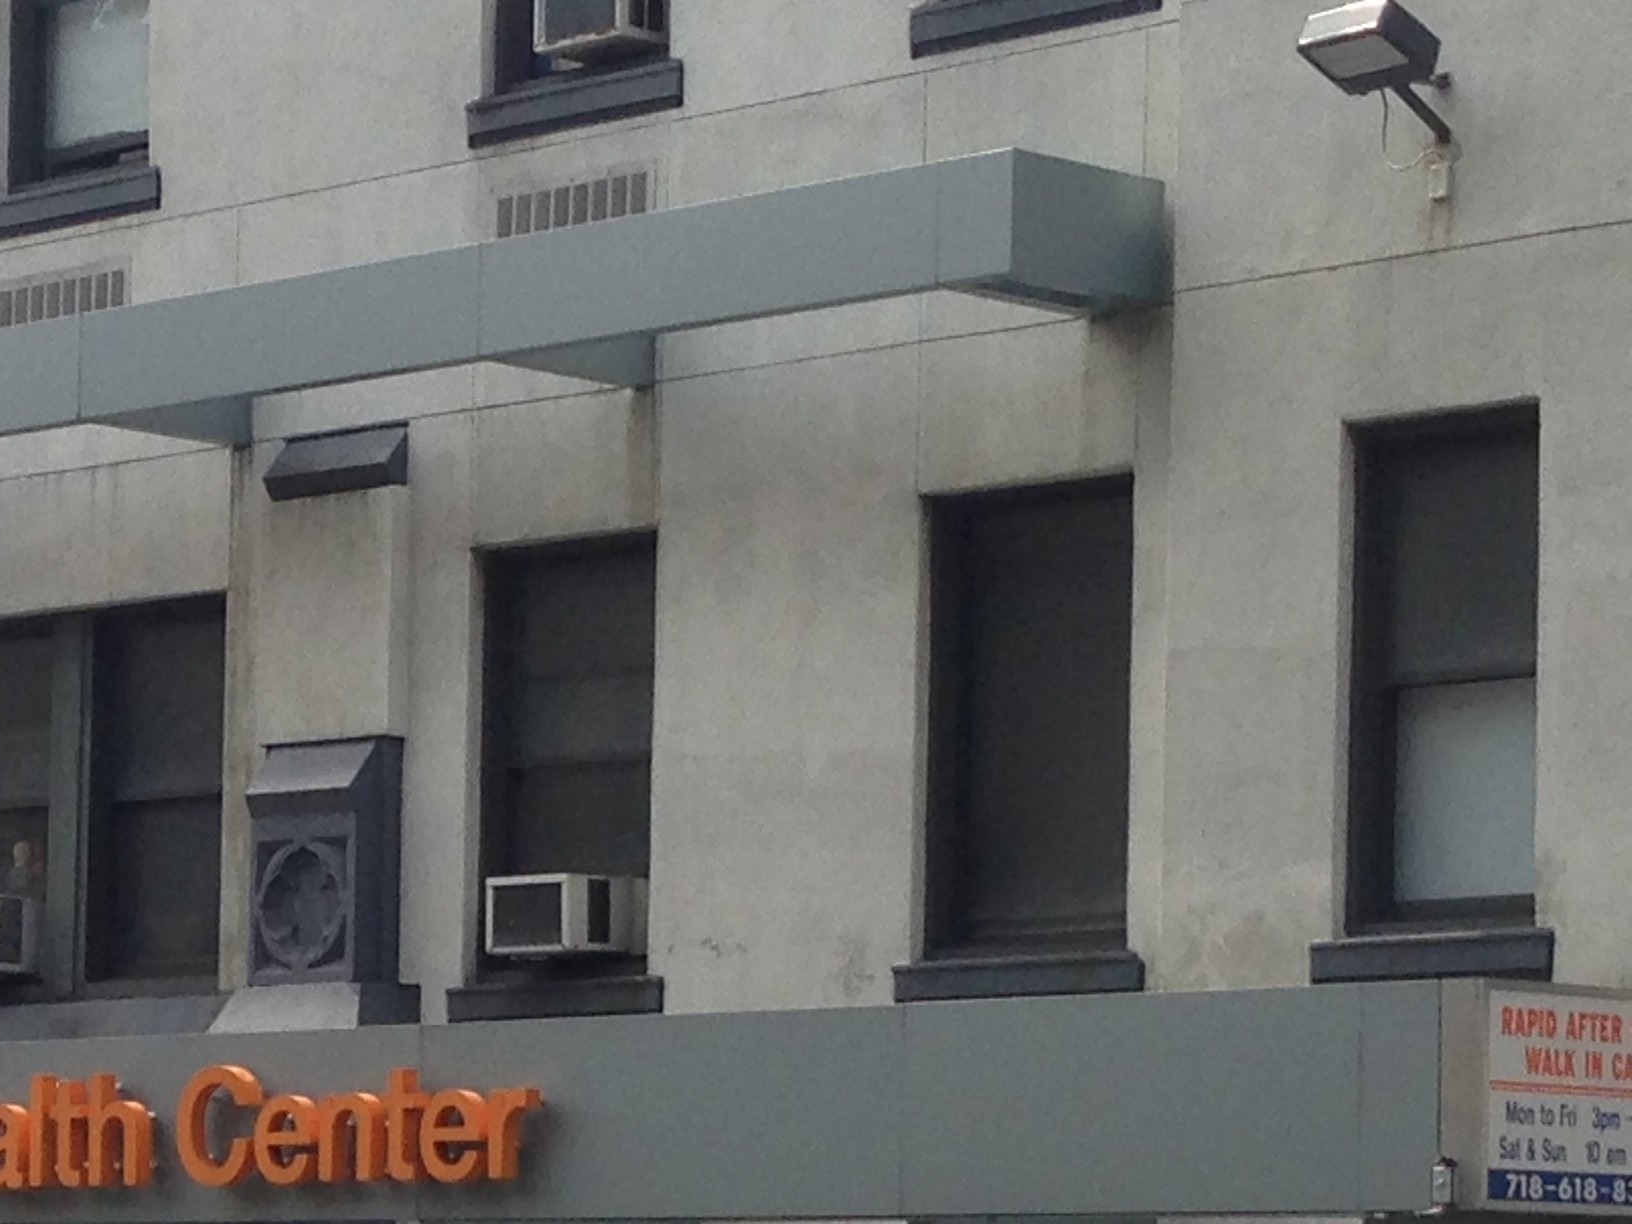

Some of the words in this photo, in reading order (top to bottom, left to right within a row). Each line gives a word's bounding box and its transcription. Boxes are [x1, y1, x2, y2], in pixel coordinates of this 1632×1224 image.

[1501, 1005, 1557, 1039] RAPID
[1566, 1010, 1622, 1044] AFTER
[1525, 1046, 1575, 1078] WALK
[1585, 1050, 1603, 1079] IN
[176, 1064, 541, 1187] Center
[1505, 1100, 1535, 1125] Mon
[1540, 1103, 1556, 1126] to
[1560, 1103, 1578, 1127] Fri
[1499, 1135, 1521, 1160] Sat
[1526, 1138, 1536, 1161] &
[1542, 1137, 1567, 1162] Sun
